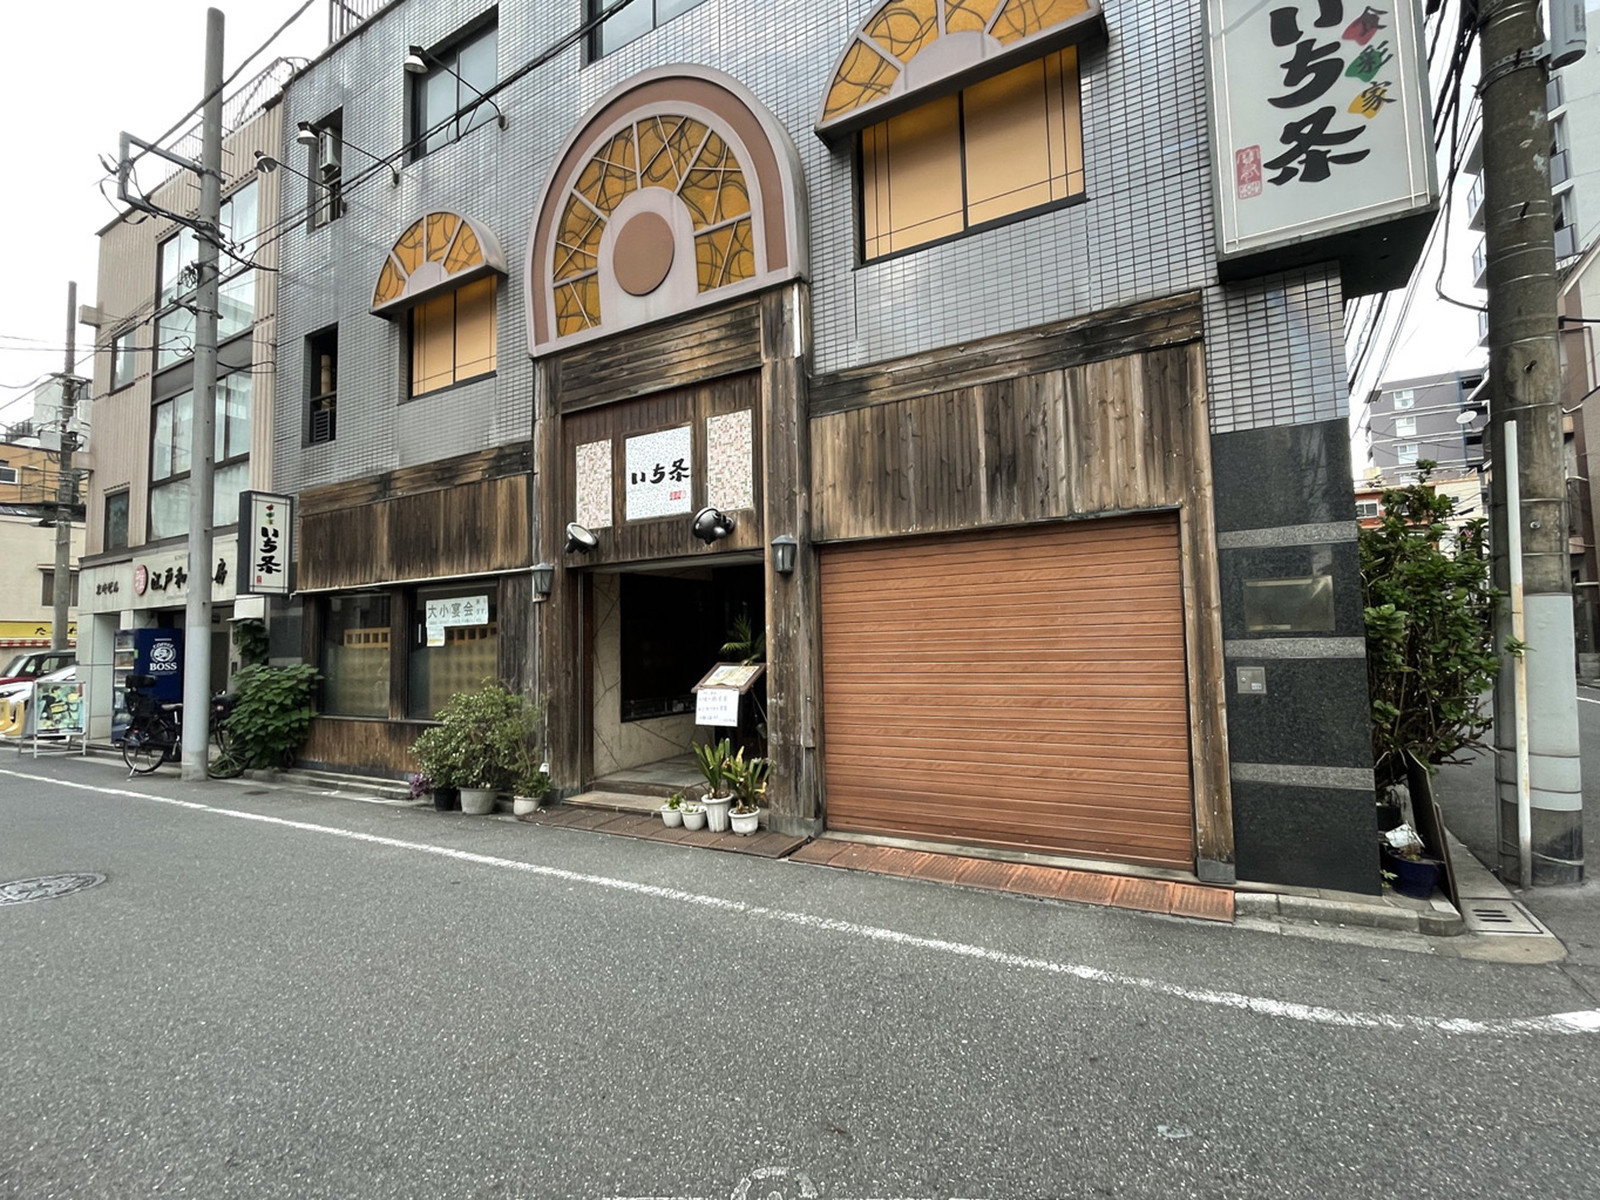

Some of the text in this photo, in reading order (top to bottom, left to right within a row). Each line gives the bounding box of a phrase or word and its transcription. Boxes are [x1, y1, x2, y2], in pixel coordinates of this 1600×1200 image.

[1356, 5, 1398, 114] 食彩家
[1263, 0, 1371, 186] いち条
[631, 458, 690, 485] いち条
[256, 526, 282, 574] いち条
[428, 601, 474, 619] 大小宴会
[149, 662, 178, 671] BOSS
